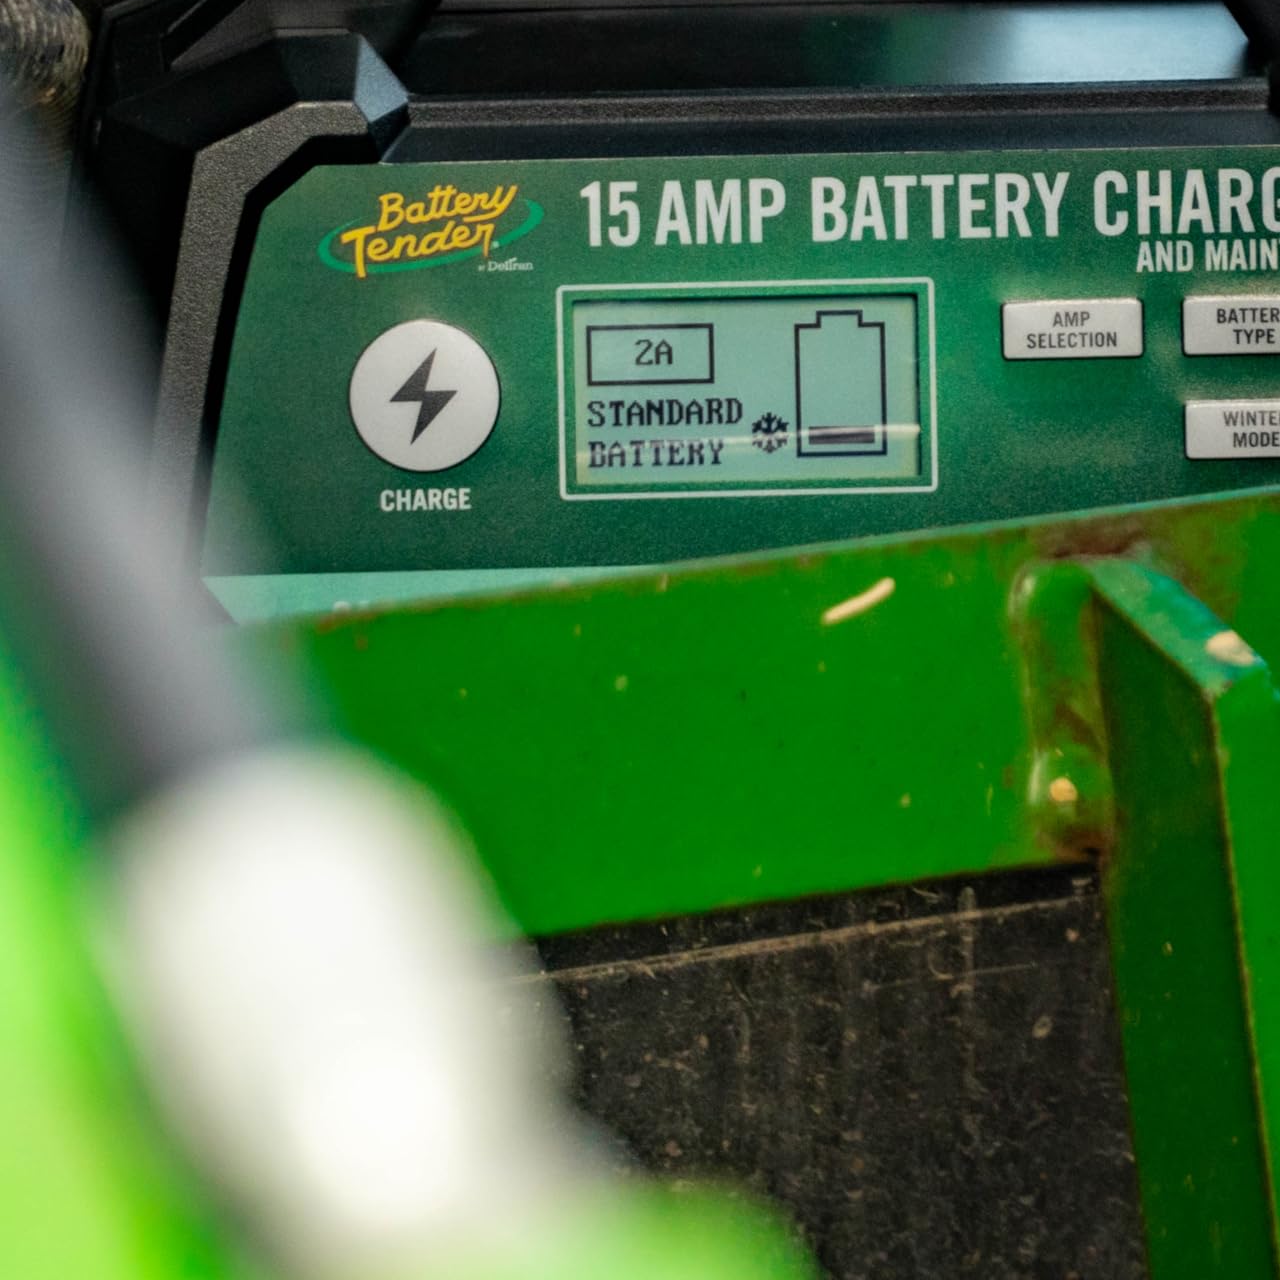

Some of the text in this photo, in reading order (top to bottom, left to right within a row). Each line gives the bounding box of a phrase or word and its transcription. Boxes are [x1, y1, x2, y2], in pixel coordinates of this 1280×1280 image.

[378, 184, 519, 232] Battery
[580, 181, 642, 248] 15
[654, 177, 786, 245] AMP
[811, 171, 1070, 243] BATTERY
[340, 220, 495, 278] Tender
[1136, 240, 1194, 274] AND
[1052, 311, 1091, 328] AMP
[1026, 330, 1118, 350] SELECTION
[1233, 327, 1277, 346] TYPE
[634, 339, 674, 366] 2A
[587, 398, 743, 428] STANDARD
[588, 438, 725, 469] BATTERY
[1232, 430, 1280, 449] MODE
[380, 487, 472, 513] CHARGE
